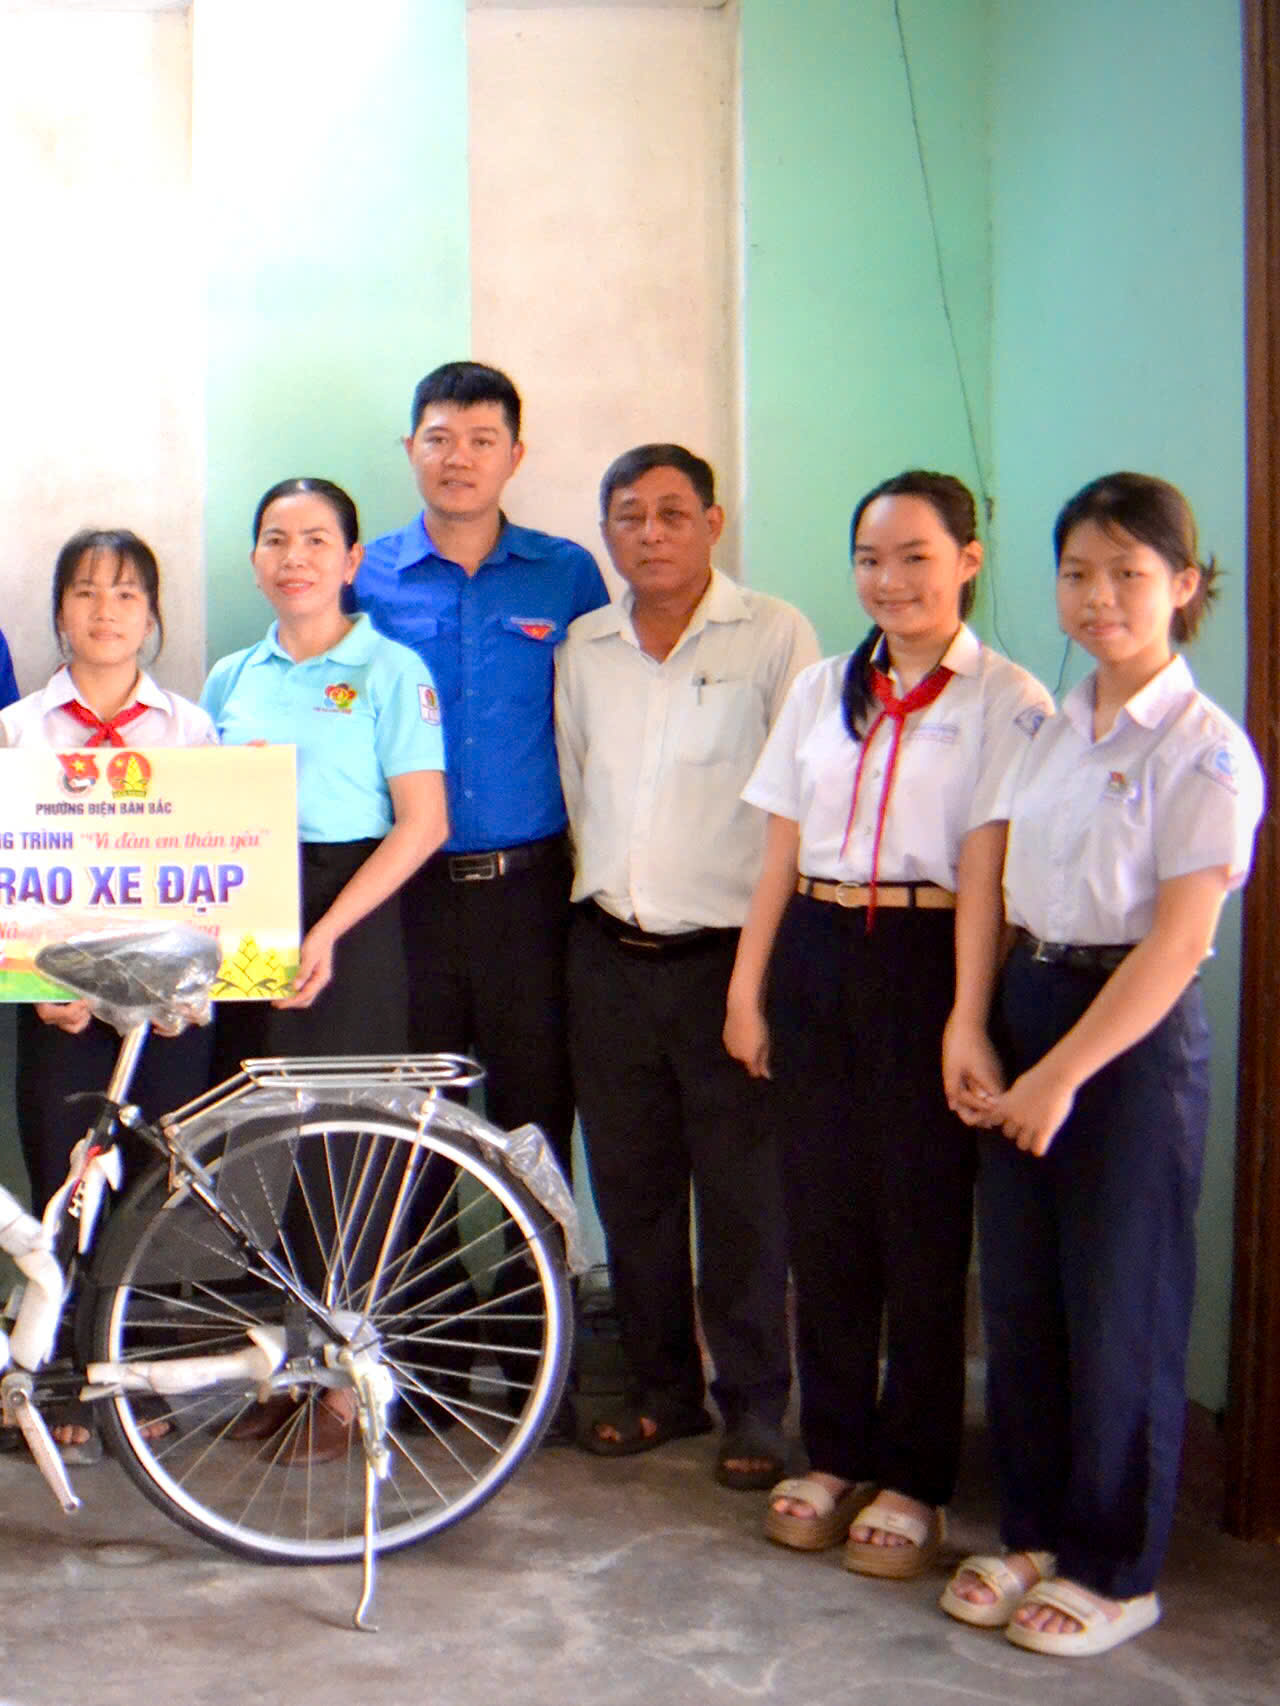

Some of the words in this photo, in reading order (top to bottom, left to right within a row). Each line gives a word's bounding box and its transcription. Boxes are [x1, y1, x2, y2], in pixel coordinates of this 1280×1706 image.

[20, 827, 74, 850] TRÌNH
[87, 865, 143, 905] XE
[156, 863, 245, 914] ĐẠP
